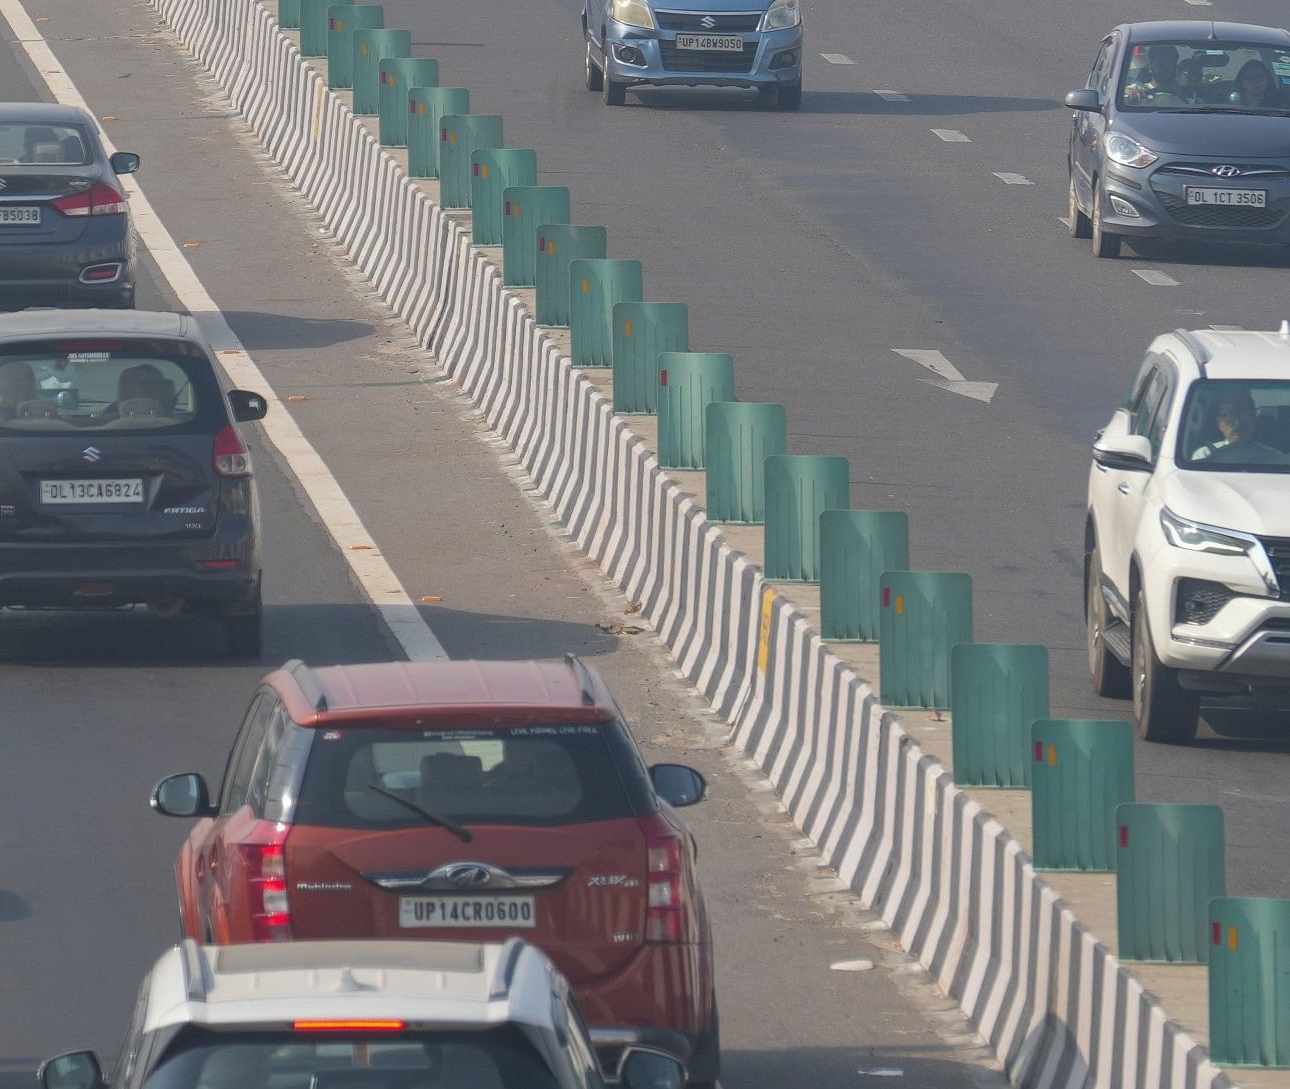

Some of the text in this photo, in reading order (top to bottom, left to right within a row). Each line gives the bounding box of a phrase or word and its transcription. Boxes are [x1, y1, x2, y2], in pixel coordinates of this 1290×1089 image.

[682, 36, 743, 50] UP14BW9050
[1195, 192, 1264, 205] DL 1CT 3506
[51, 481, 142, 502] DL13CA6824
[414, 900, 532, 925] UP14CR0600
